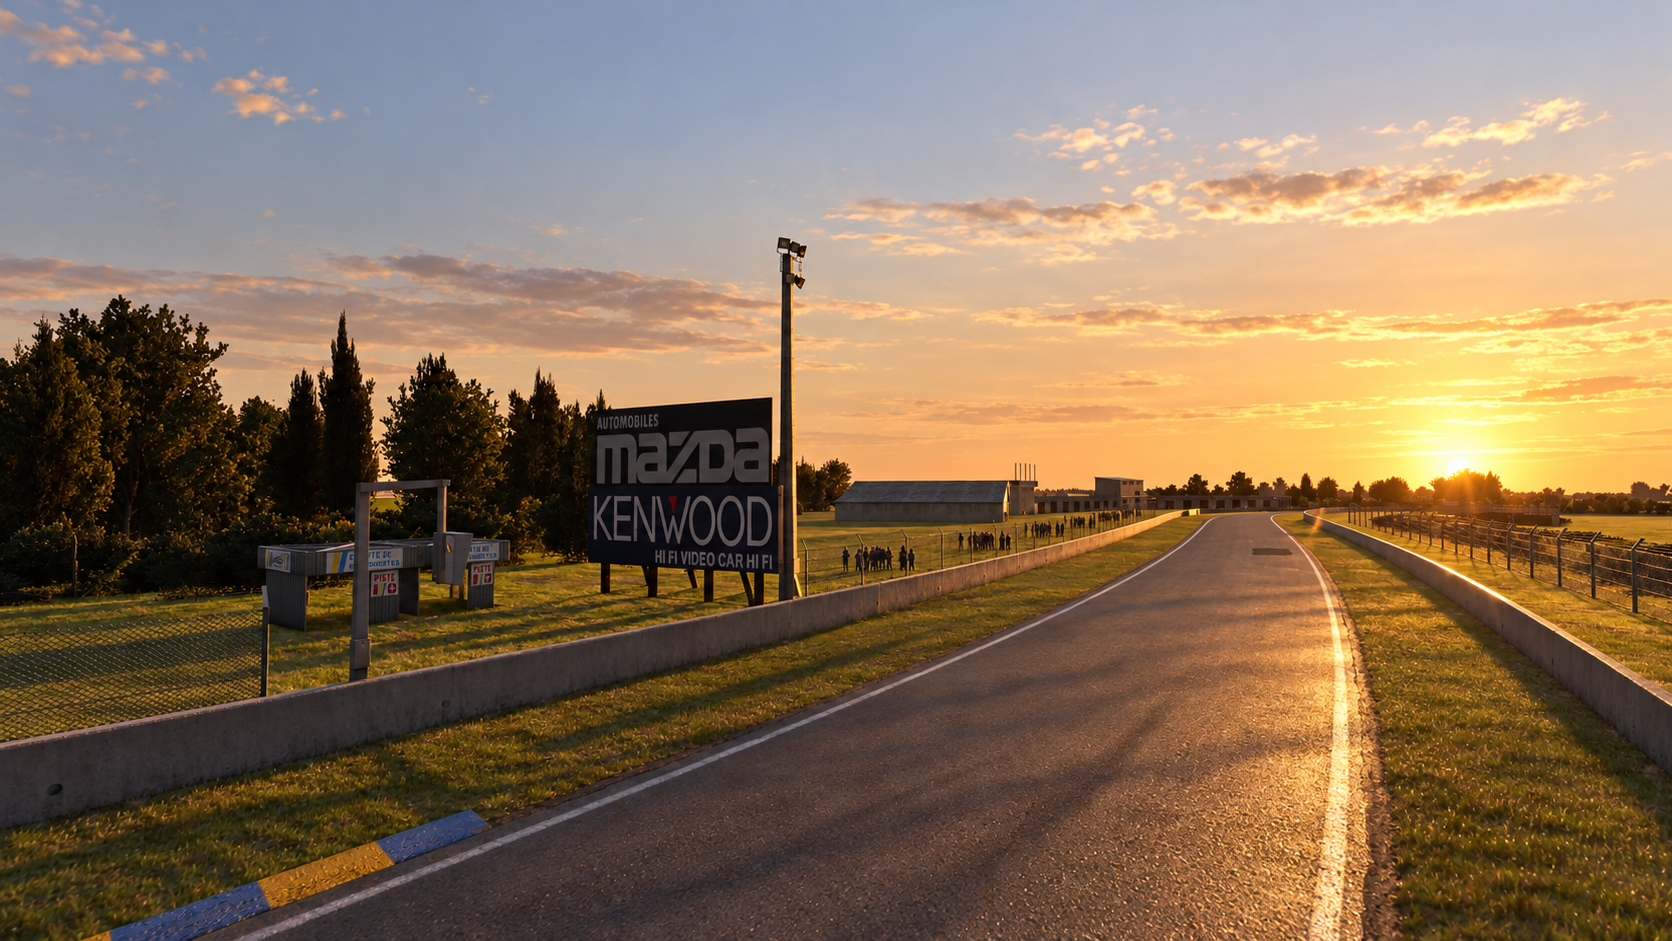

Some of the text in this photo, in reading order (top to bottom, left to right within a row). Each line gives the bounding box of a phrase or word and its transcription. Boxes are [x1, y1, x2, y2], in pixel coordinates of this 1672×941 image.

[597, 413, 659, 429] AUTOMOBILES
[593, 495, 773, 547] KENWOOD
[655, 550, 773, 570] HI FI VIDEO CAR HI FI
